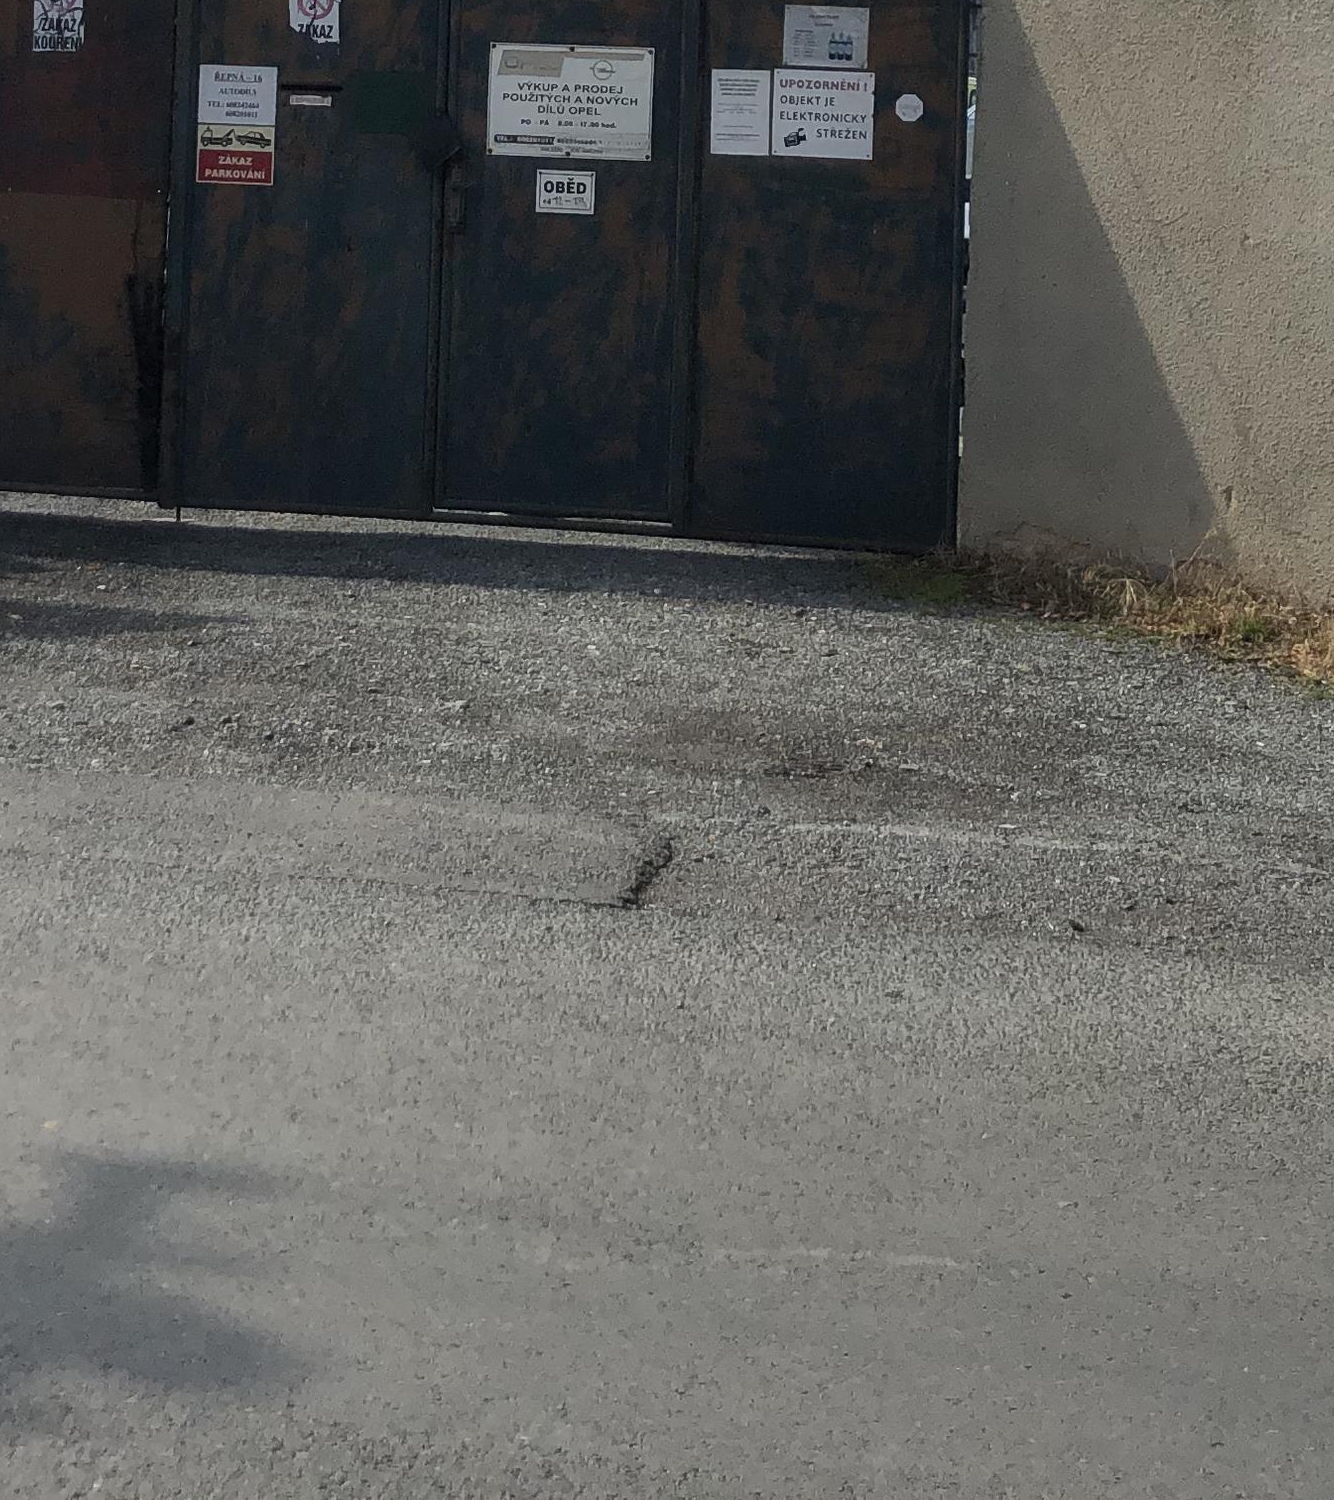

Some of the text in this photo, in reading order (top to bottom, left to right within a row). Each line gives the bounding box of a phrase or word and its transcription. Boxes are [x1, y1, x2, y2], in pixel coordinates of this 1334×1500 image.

[517, 81, 623, 95] VÝKUP A PRODEJ
[779, 78, 860, 91] UPOZORNĚNÍ
[503, 91, 638, 106] POUŽITÝCH A NOVÝCH
[780, 95, 835, 107] OBJEKT JE
[537, 104, 601, 116] DÍLŮ OPEL
[779, 111, 867, 123] ELEKTRONICKY
[816, 126, 867, 140] STŘEŽEN
[218, 155, 253, 166] ZÁKAZ
[204, 168, 266, 180] PARKOVÁNÍ
[544, 177, 587, 194] OBĚD
